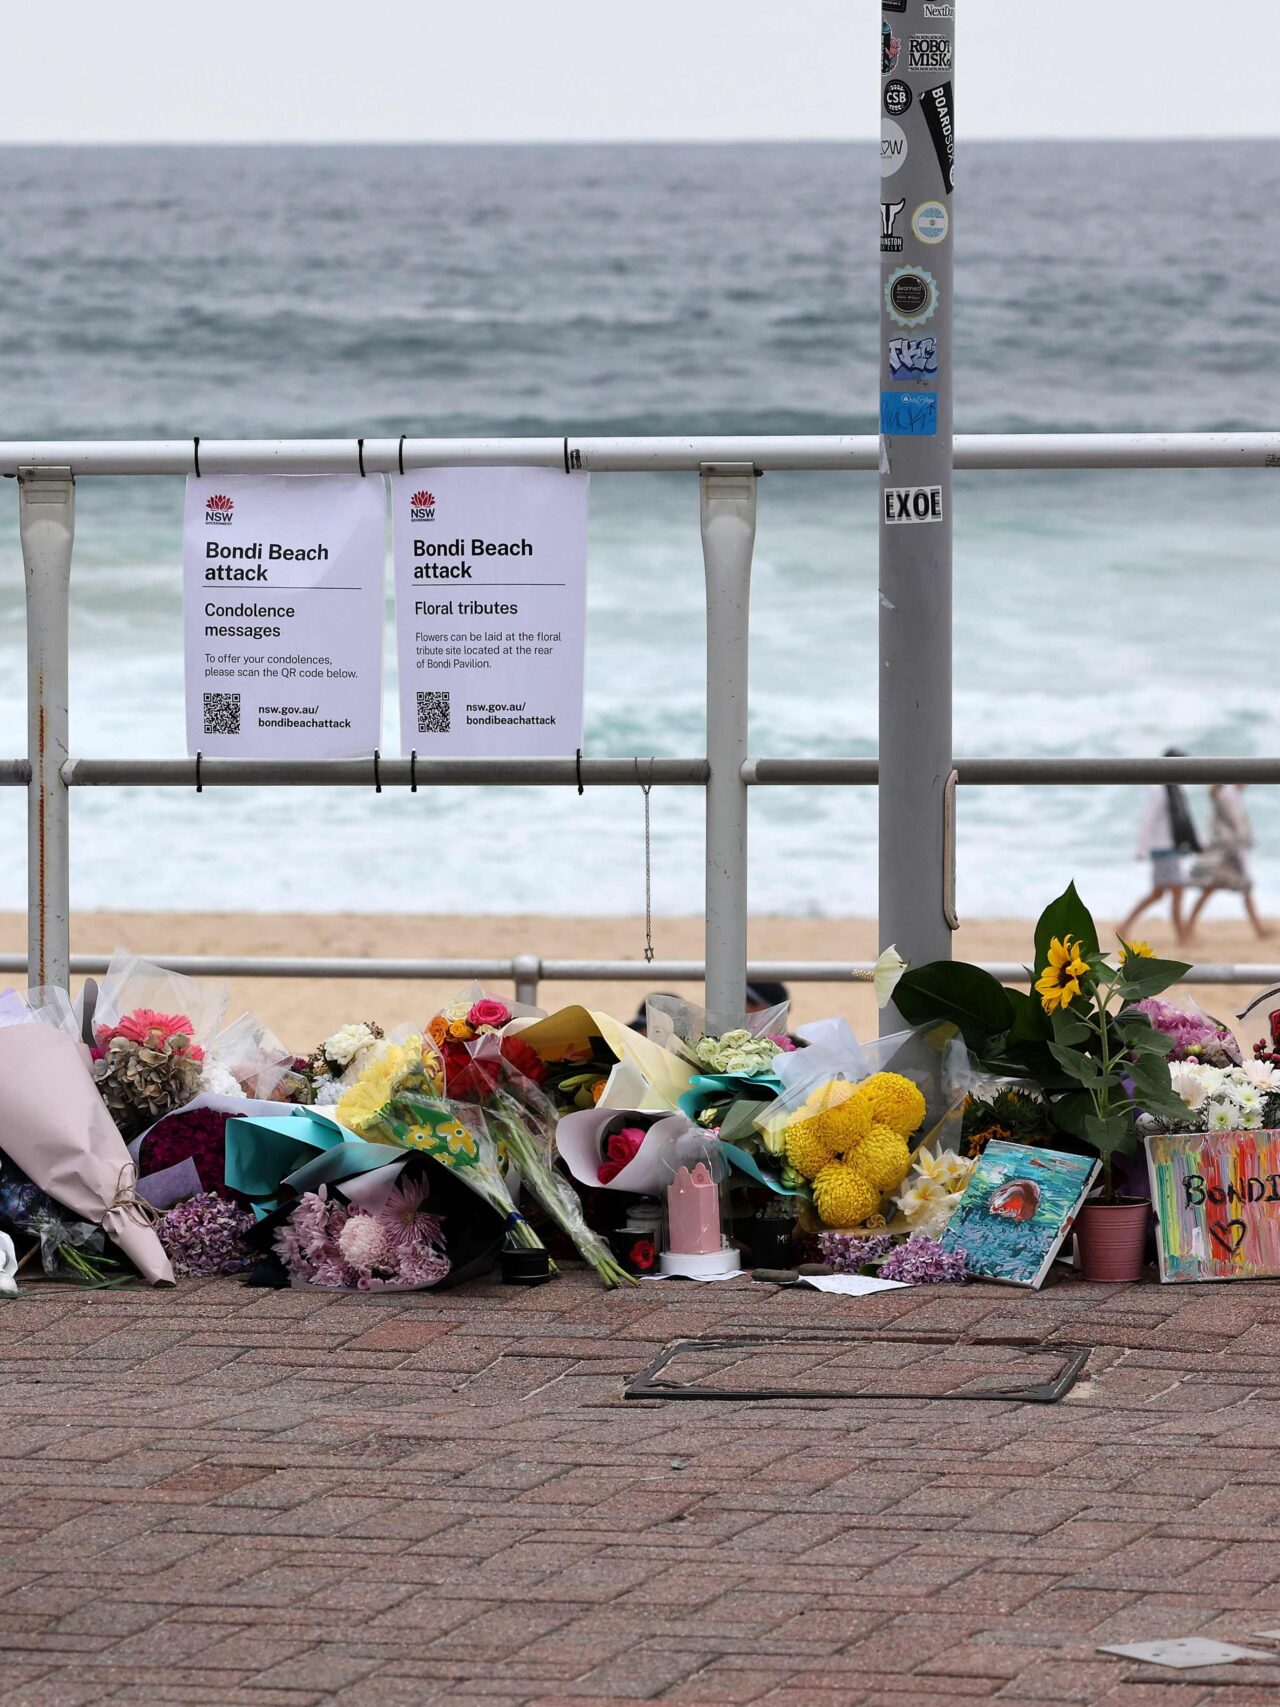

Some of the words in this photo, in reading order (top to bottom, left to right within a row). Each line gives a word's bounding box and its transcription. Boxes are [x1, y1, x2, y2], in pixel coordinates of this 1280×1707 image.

[886, 92, 907, 103] CSB
[886, 488, 941, 521] EXOE
[206, 511, 233, 522] NSW
[411, 508, 435, 518] NSW
[206, 542, 262, 559] Bondi
[269, 544, 328, 561] Beach
[414, 539, 464, 556] Bondi
[472, 539, 532, 556] Beach
[205, 564, 267, 581] attack
[414, 561, 472, 578] attack
[205, 603, 294, 617] Condolence
[416, 601, 453, 615] Floral
[458, 601, 517, 614] tributes
[205, 626, 280, 639] messages
[416, 632, 448, 641] Flowers
[470, 632, 482, 641] be
[485, 632, 502, 641] laid
[506, 633, 515, 641] at
[519, 632, 534, 641] the
[538, 632, 561, 641] floral
[417, 646, 443, 655] tribute
[446, 646, 461, 655] site
[464, 645, 499, 654] located
[503, 646, 512, 654] at
[516, 645, 531, 654] the
[205, 654, 215, 662] To
[218, 654, 240, 663] offer
[244, 656, 264, 665] your
[268, 655, 332, 665] condolences,
[417, 659, 424, 668] of
[428, 659, 450, 668] Bondi
[454, 659, 491, 668] Pavilion.
[205, 667, 234, 677] please
[263, 668, 278, 677] the
[281, 668, 296, 678] QR
[299, 669, 323, 677] code
[327, 669, 357, 678] below.
[259, 706, 319, 715] nsw.gov.au/
[467, 703, 525, 713] nsw.gov.au/
[259, 718, 350, 727] bondibeachattack
[467, 715, 555, 724] bondibeachattack
